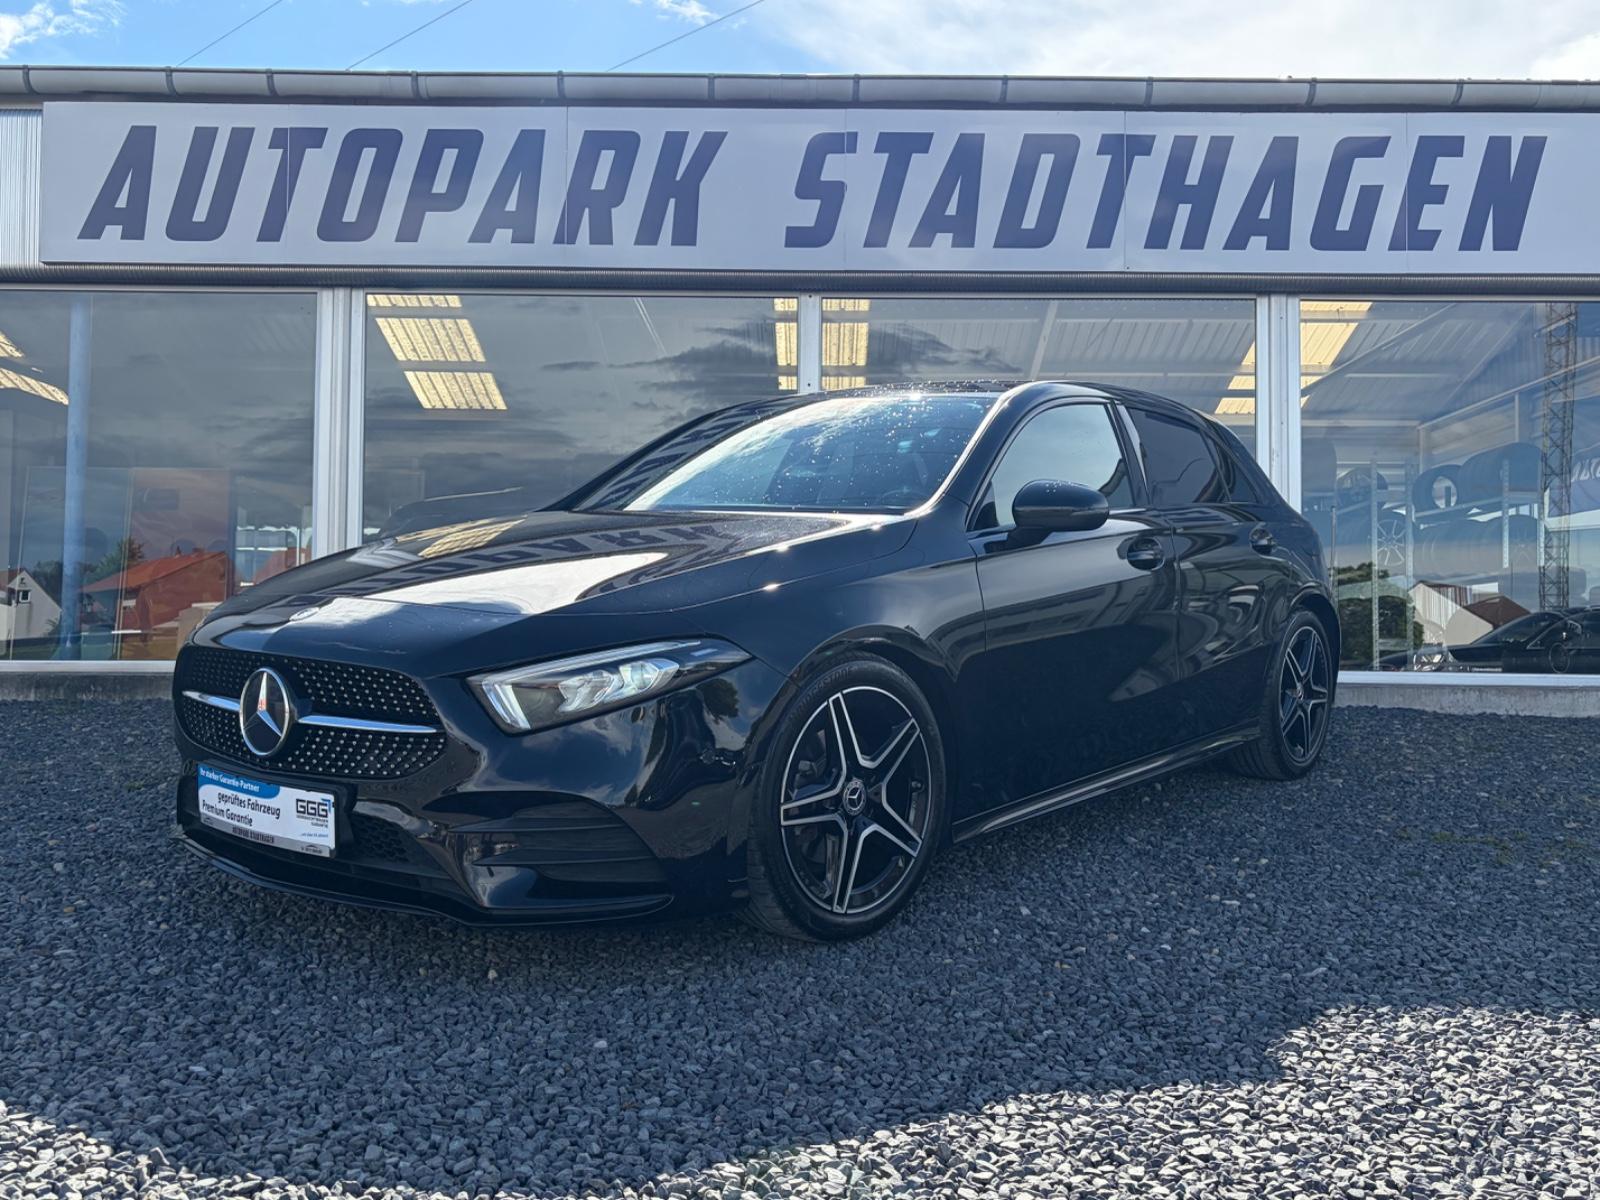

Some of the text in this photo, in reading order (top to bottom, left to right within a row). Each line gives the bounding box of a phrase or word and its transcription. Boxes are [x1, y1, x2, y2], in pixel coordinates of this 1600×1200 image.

[77, 125, 1548, 252] AUTOPARK STADTHAGEN
[202, 799, 253, 827] Premium Garantie
[217, 791, 247, 809] geprüftes
[247, 798, 281, 820] Fahrzeug
[296, 798, 329, 818] GGG
